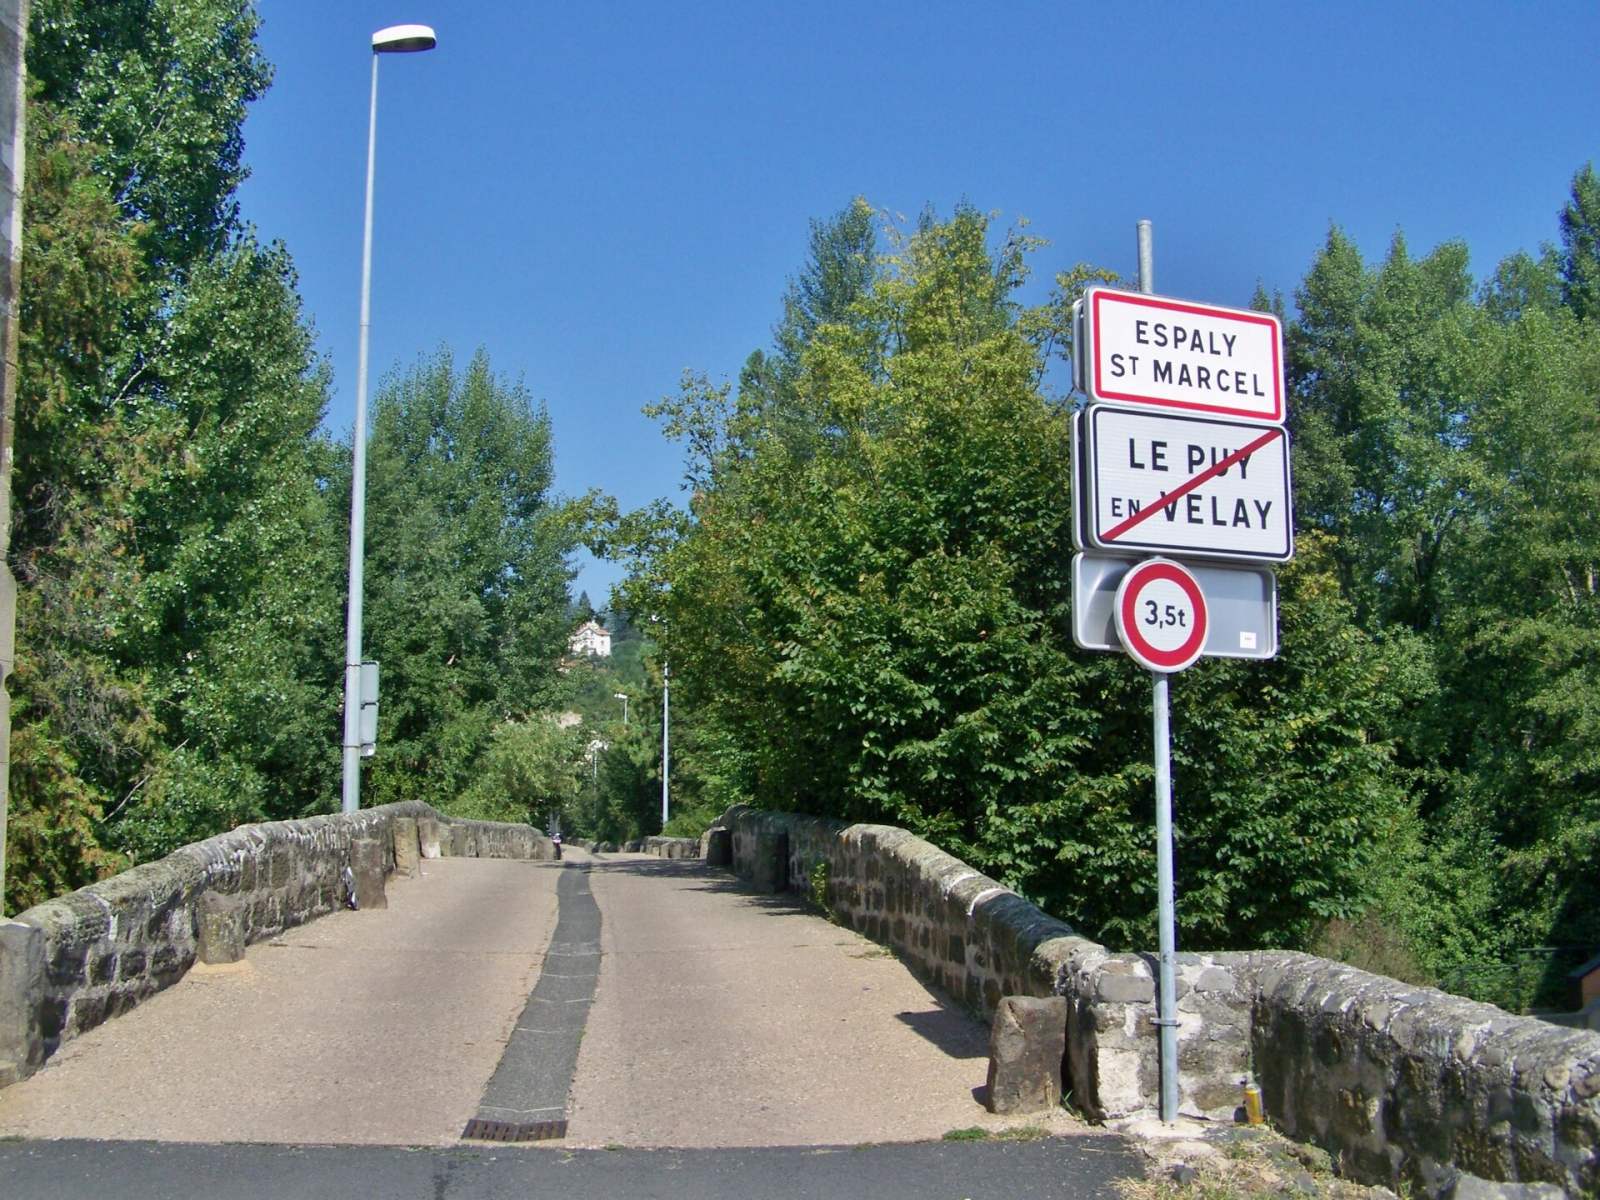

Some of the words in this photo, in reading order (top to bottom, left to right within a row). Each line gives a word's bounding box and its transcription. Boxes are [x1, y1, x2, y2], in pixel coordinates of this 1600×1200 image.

[1136, 320, 1237, 357] ESPALY
[1153, 360, 1265, 397] MARCEL
[1129, 438, 1168, 471] LE
[1187, 444, 1251, 479] PUY
[1111, 497, 1140, 518] EN
[1160, 491, 1273, 529] VELAY
[1144, 600, 1186, 630] 3,5t
